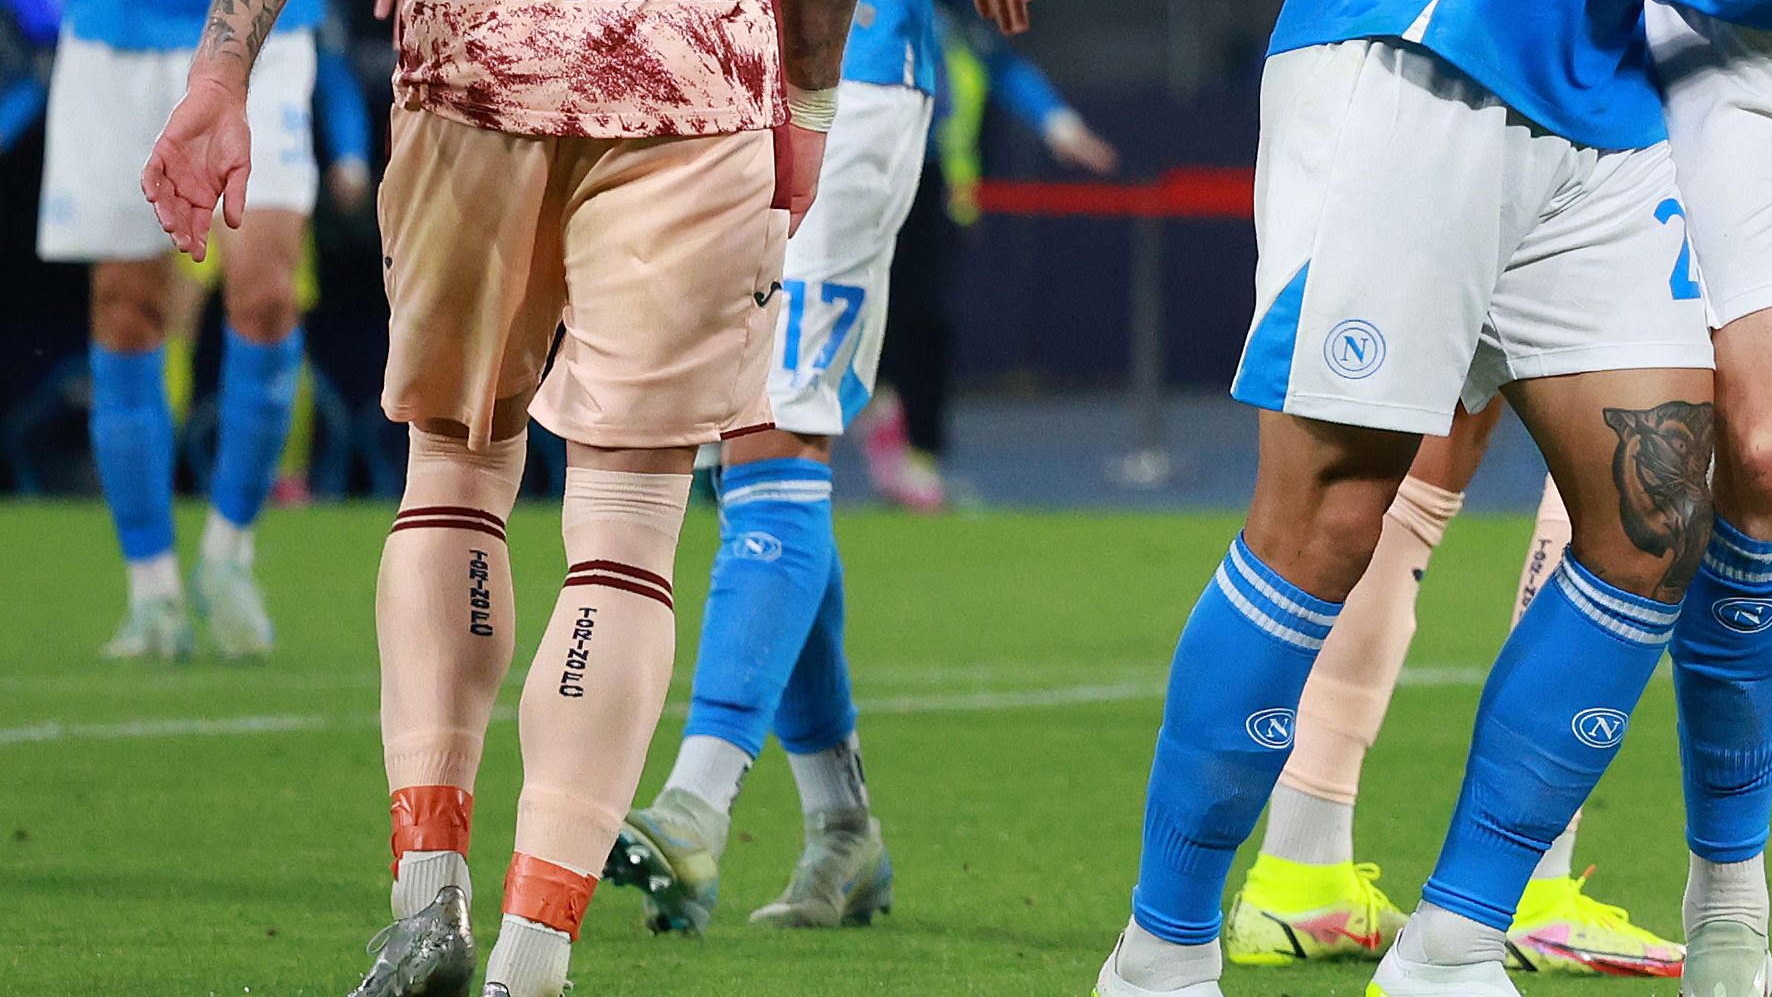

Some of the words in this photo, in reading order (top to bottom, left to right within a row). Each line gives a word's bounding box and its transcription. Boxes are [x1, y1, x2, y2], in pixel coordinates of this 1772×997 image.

[1653, 198, 1702, 300] 2
[782, 279, 866, 371] 17
[1341, 335, 1369, 364] N
